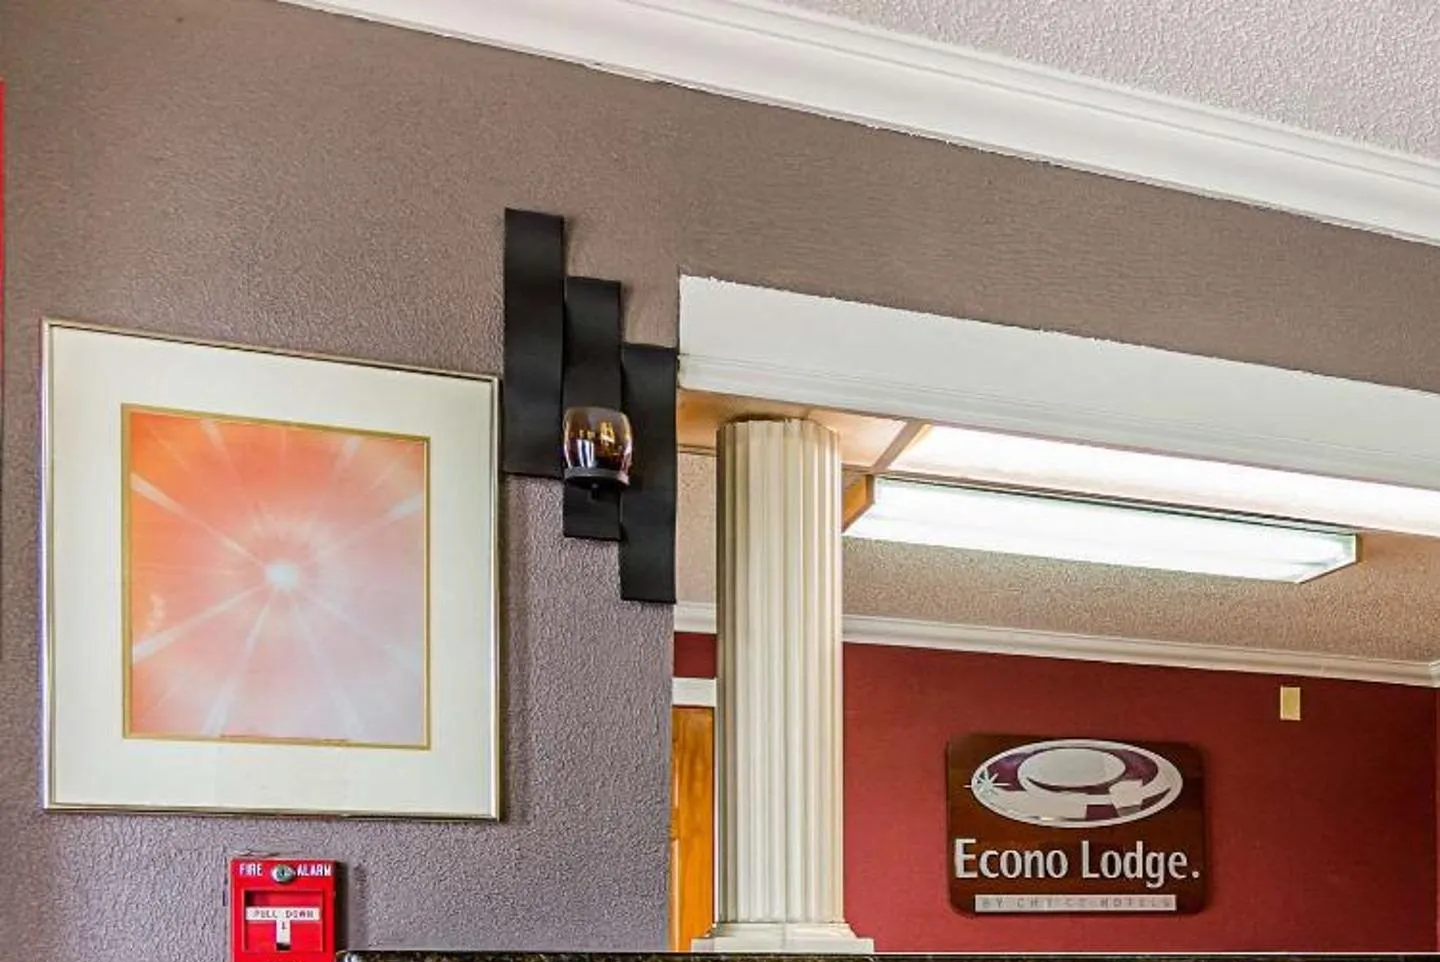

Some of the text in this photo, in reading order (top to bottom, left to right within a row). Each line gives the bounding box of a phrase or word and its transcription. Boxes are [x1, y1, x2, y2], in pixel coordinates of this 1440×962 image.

[954, 838, 1069, 879] Econo
[239, 863, 332, 877] FIRE ALARM
[1016, 896, 1088, 909] CHCE
[252, 909, 314, 919] PULL DOWN
